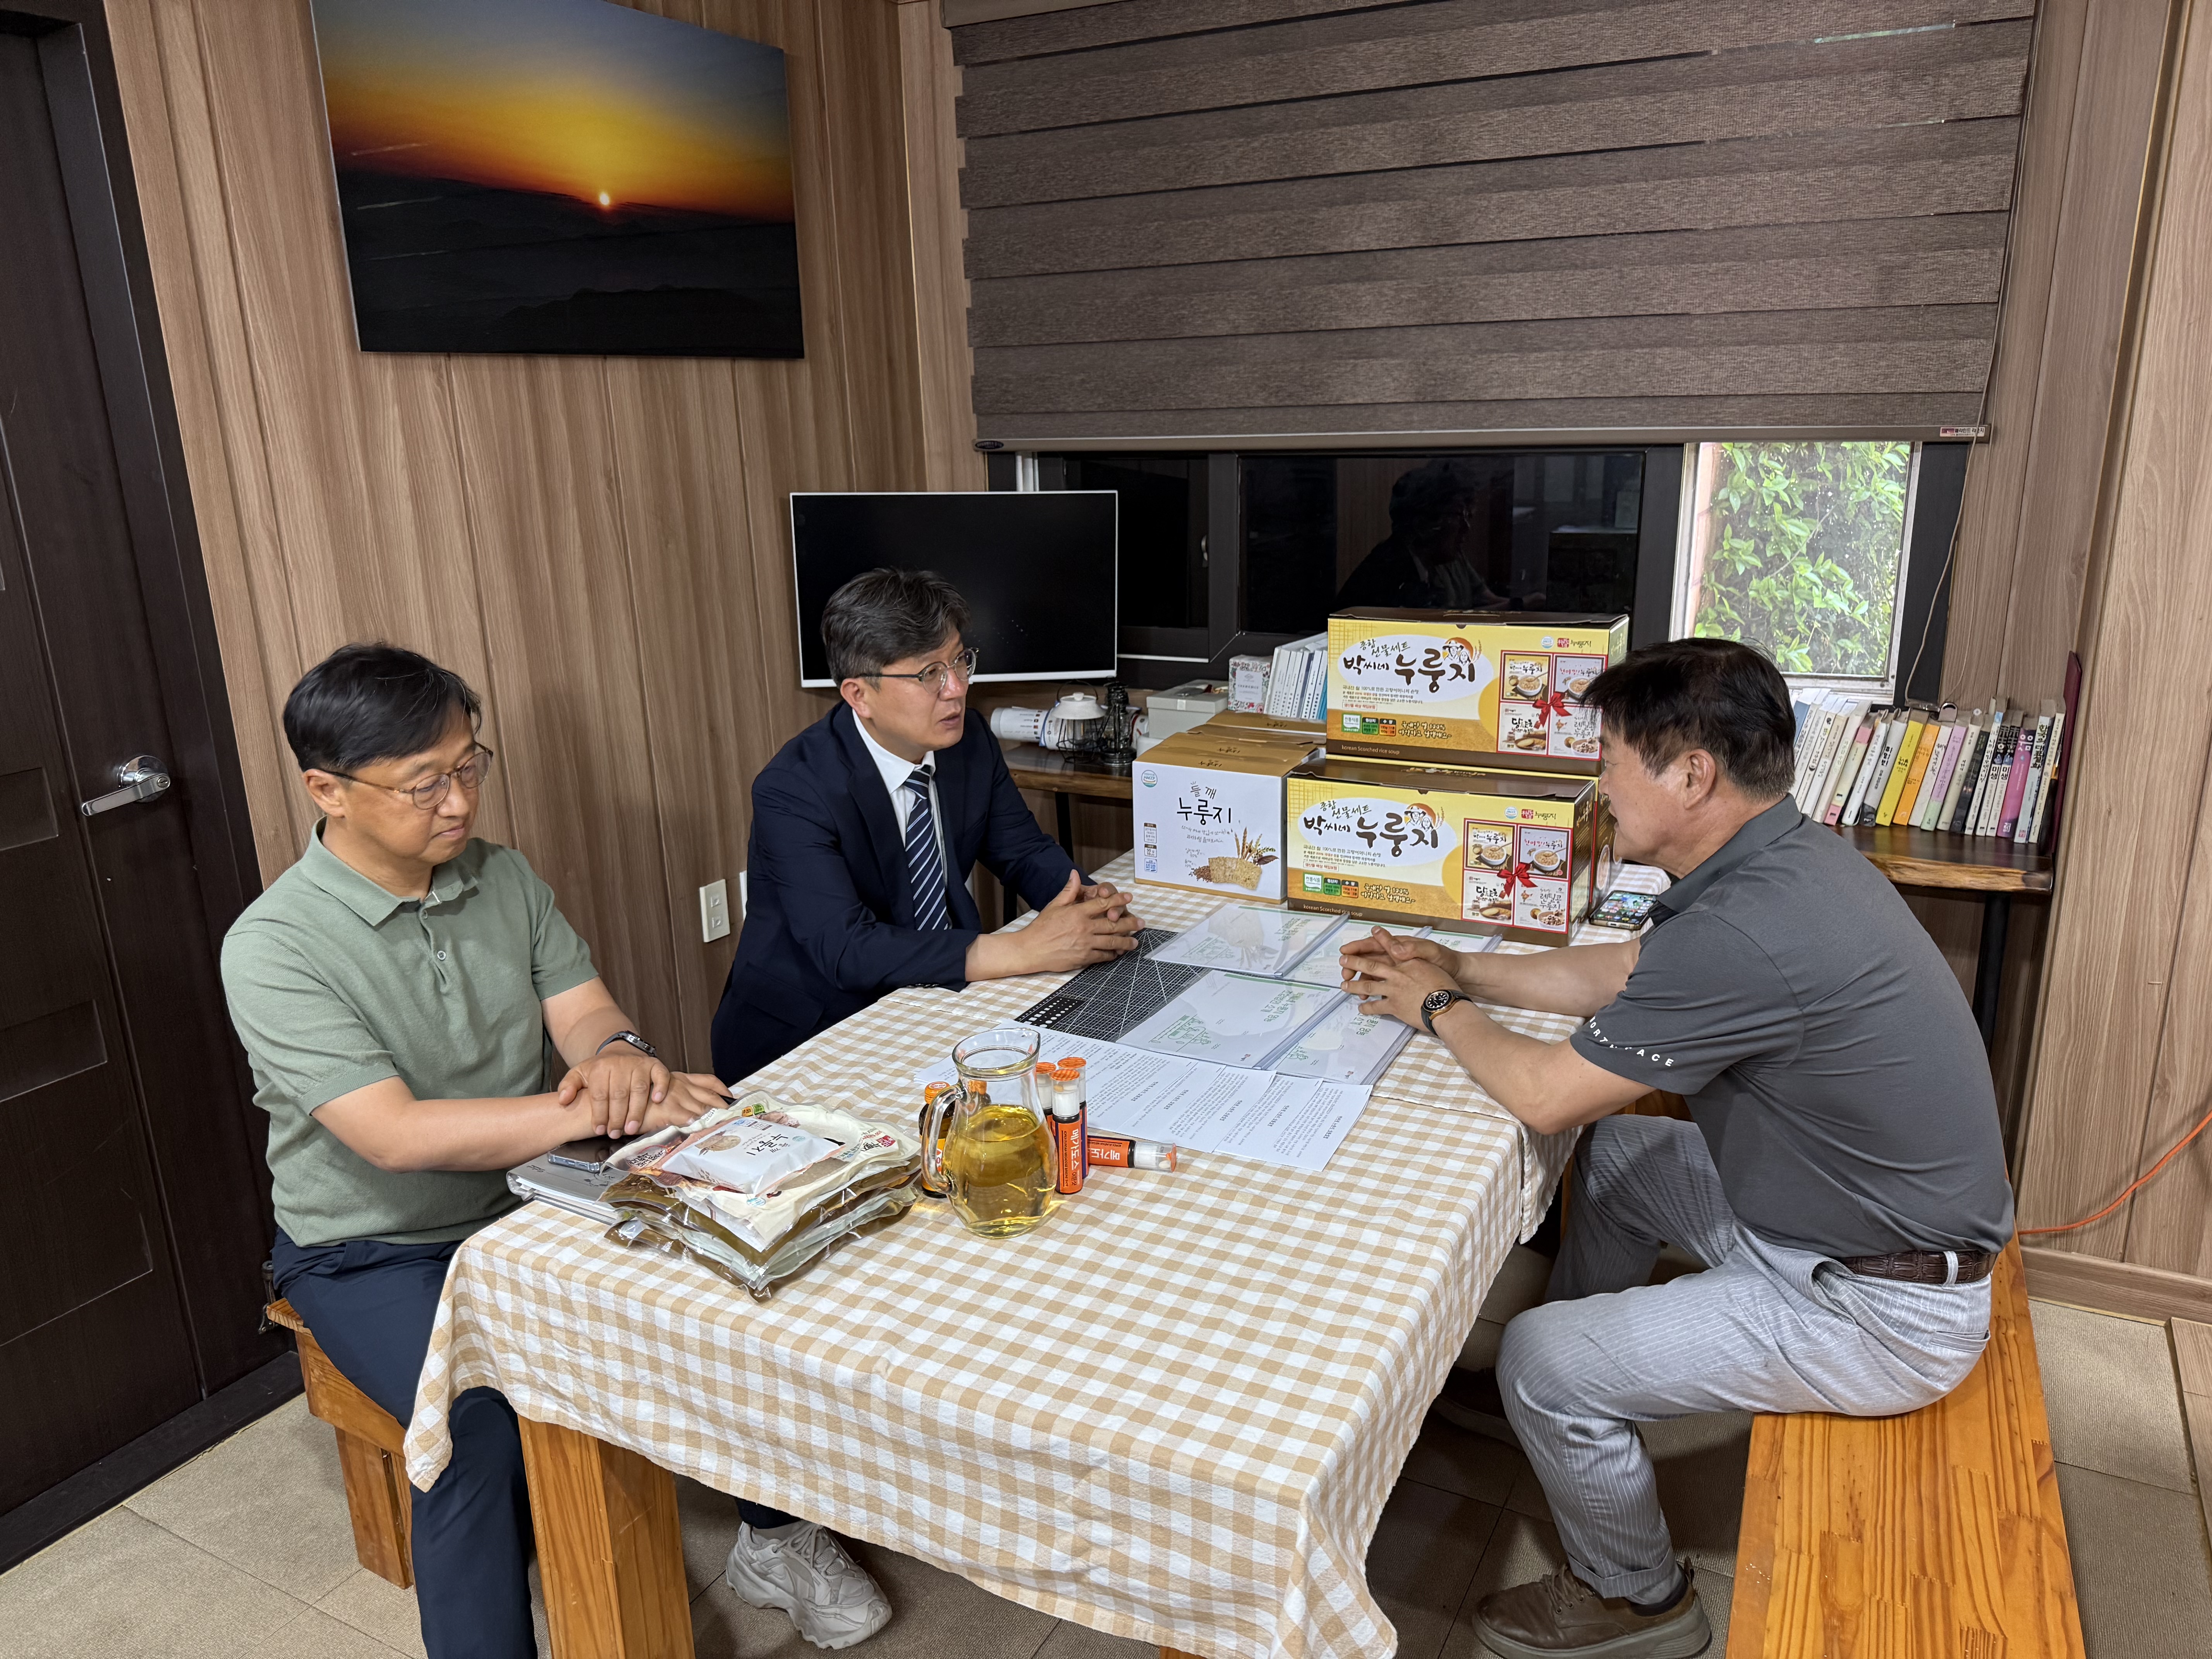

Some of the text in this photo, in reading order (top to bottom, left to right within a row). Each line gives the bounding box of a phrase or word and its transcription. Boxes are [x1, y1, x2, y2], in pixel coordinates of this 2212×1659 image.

[1360, 639, 1376, 649] 종합
[1372, 641, 1410, 657] 선물세트
[1570, 640, 1591, 648] 누룽지
[1343, 648, 1475, 693] 박씨네 누룽지
[2017, 733, 2034, 752] 웃음
[1990, 765, 2001, 780] 미생
[2000, 765, 2010, 781] 미생
[1176, 797, 1231, 826] 누룽지
[1320, 800, 1336, 811] 종합
[1332, 805, 1372, 819] 선물세트
[1535, 811, 1556, 821] 누룽지
[1304, 812, 1438, 857] 박씨네 누룽지
[1486, 833, 1506, 845] 누룽지
[1392, 887, 1409, 895] 100%
[1539, 901, 1561, 910] 누룽지
[1540, 893, 1562, 904] 렌틸콩
[1273, 1004, 1292, 1014] 누룽지
[1625, 1047, 1674, 1066] ACE
[746, 1136, 788, 1155] 누룽지
[1070, 1128, 1080, 1171] 메가도스
[1089, 1148, 1120, 1160] 메가도
